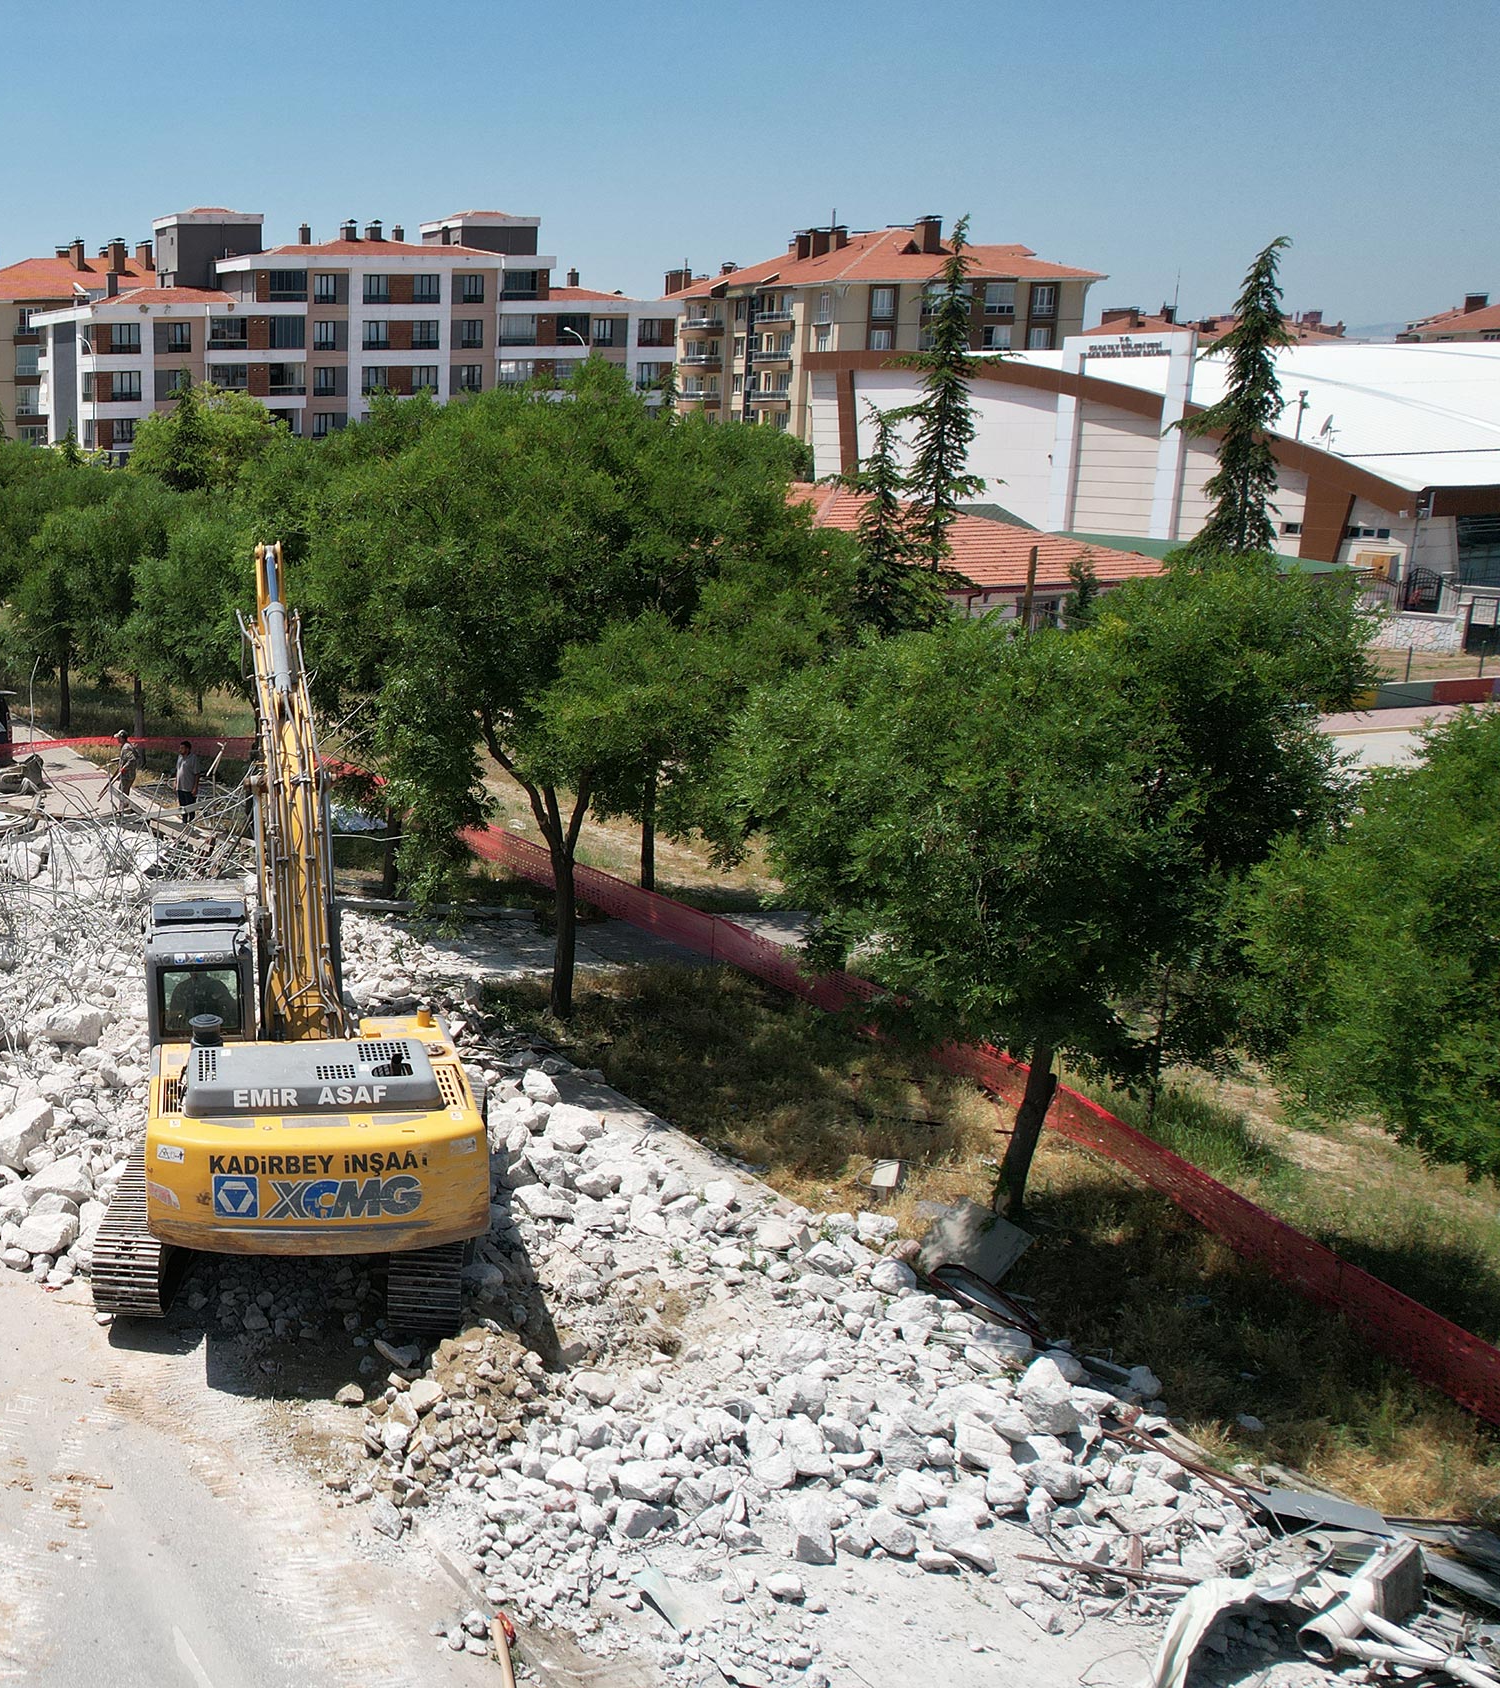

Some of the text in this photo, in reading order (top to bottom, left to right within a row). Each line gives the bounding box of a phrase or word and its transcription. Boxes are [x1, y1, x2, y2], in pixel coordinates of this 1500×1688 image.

[186, 952, 223, 964] XCMG
[318, 1085, 387, 1105] ASAF
[262, 1174, 423, 1220] XCMG
